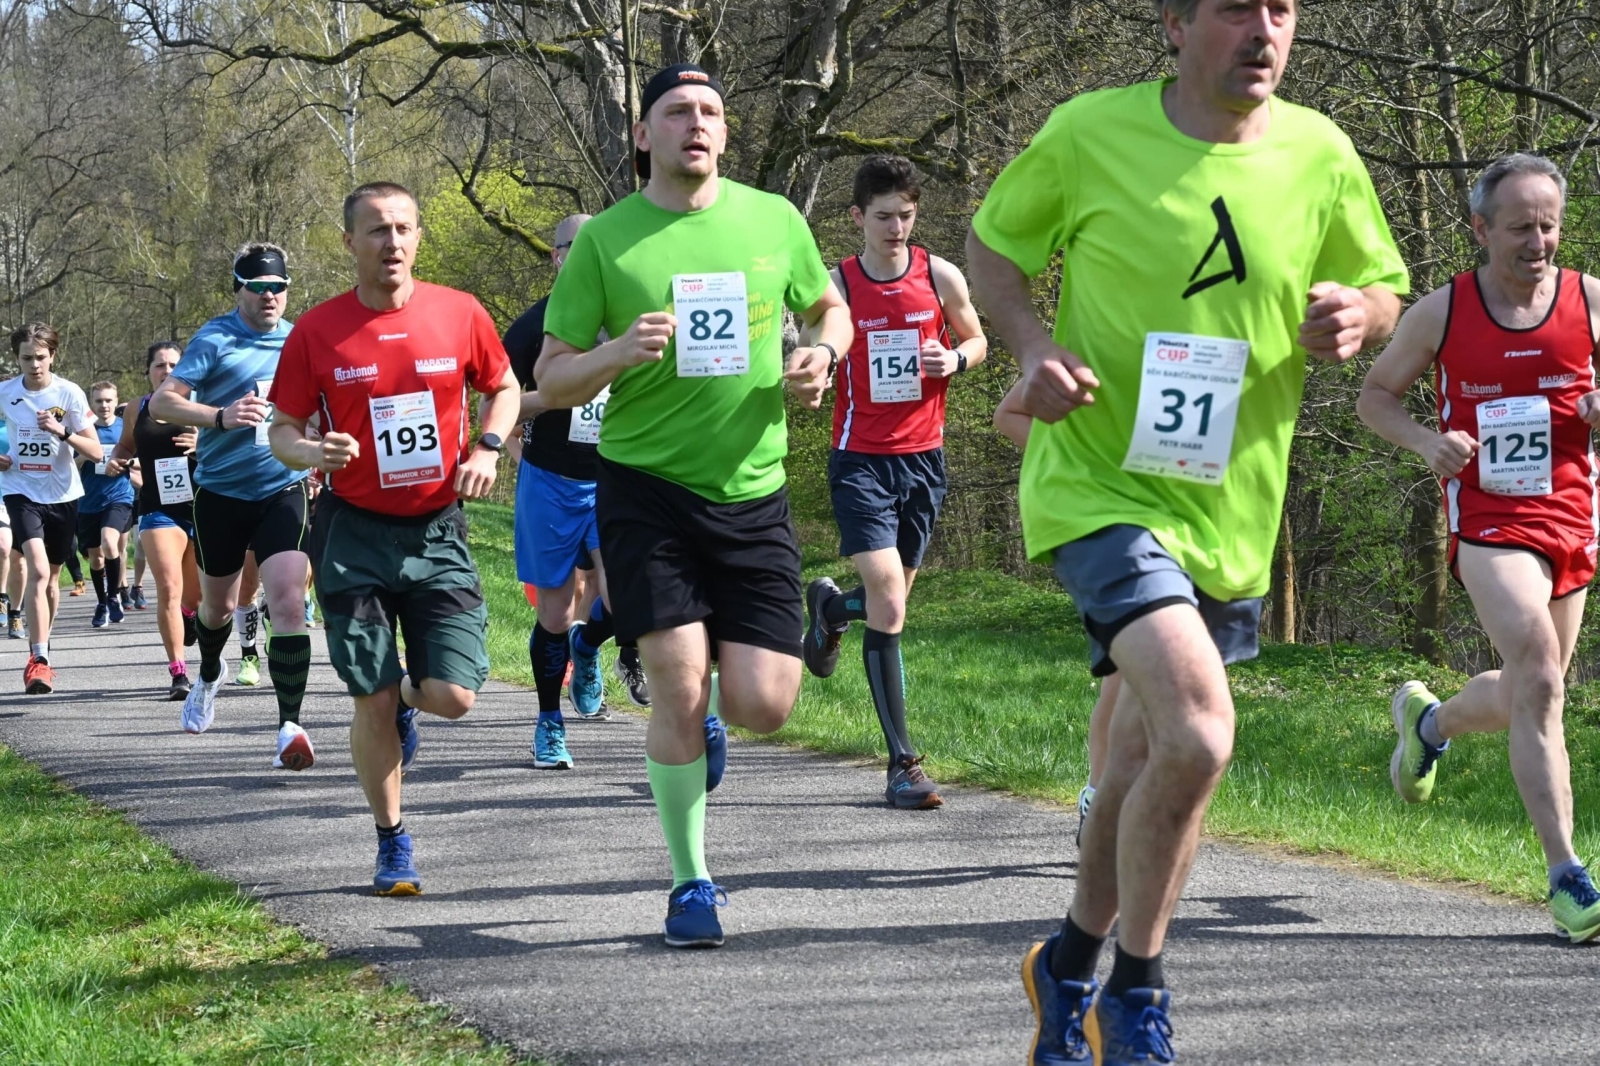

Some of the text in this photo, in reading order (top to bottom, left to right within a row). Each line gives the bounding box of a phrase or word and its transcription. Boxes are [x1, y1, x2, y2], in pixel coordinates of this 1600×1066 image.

[681, 284, 704, 292] CUP
[689, 308, 735, 341] 82
[1156, 348, 1189, 361] CUP
[415, 357, 457, 368] MARATON
[871, 355, 920, 379] 154
[375, 410, 395, 420] CUP
[581, 402, 606, 422] 80
[1154, 388, 1214, 436] 31
[1486, 409, 1507, 418] CUP
[377, 423, 438, 457] 193
[1159, 439, 1178, 448] PETR
[1482, 431, 1548, 464] 125
[18, 442, 51, 457] 295
[163, 473, 185, 489] 52
[389, 471, 418, 481] PRIMATOR
[420, 468, 435, 477] CUP
